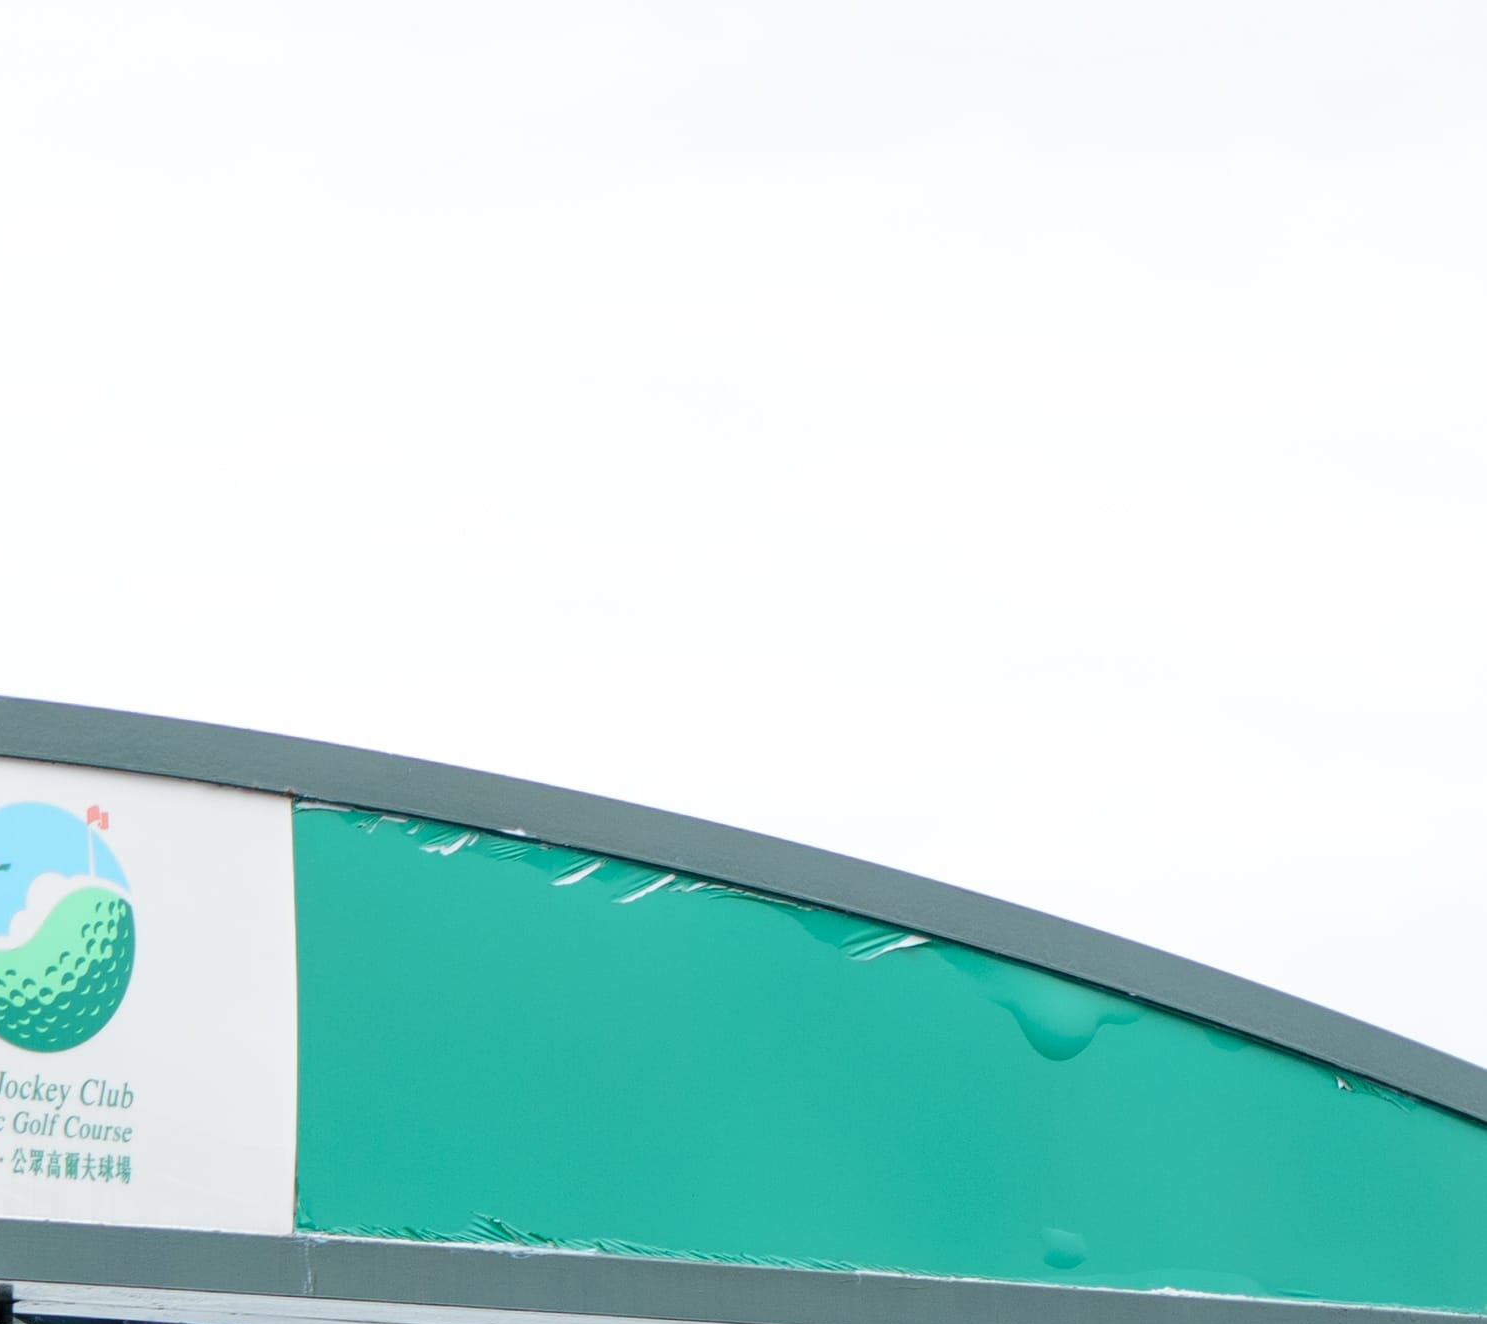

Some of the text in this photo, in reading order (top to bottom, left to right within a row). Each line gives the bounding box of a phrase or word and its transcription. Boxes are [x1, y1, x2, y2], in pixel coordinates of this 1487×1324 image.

[80, 1078, 134, 1109] Club
[12, 1110, 61, 1136] Golf
[63, 1115, 133, 1143] Course
